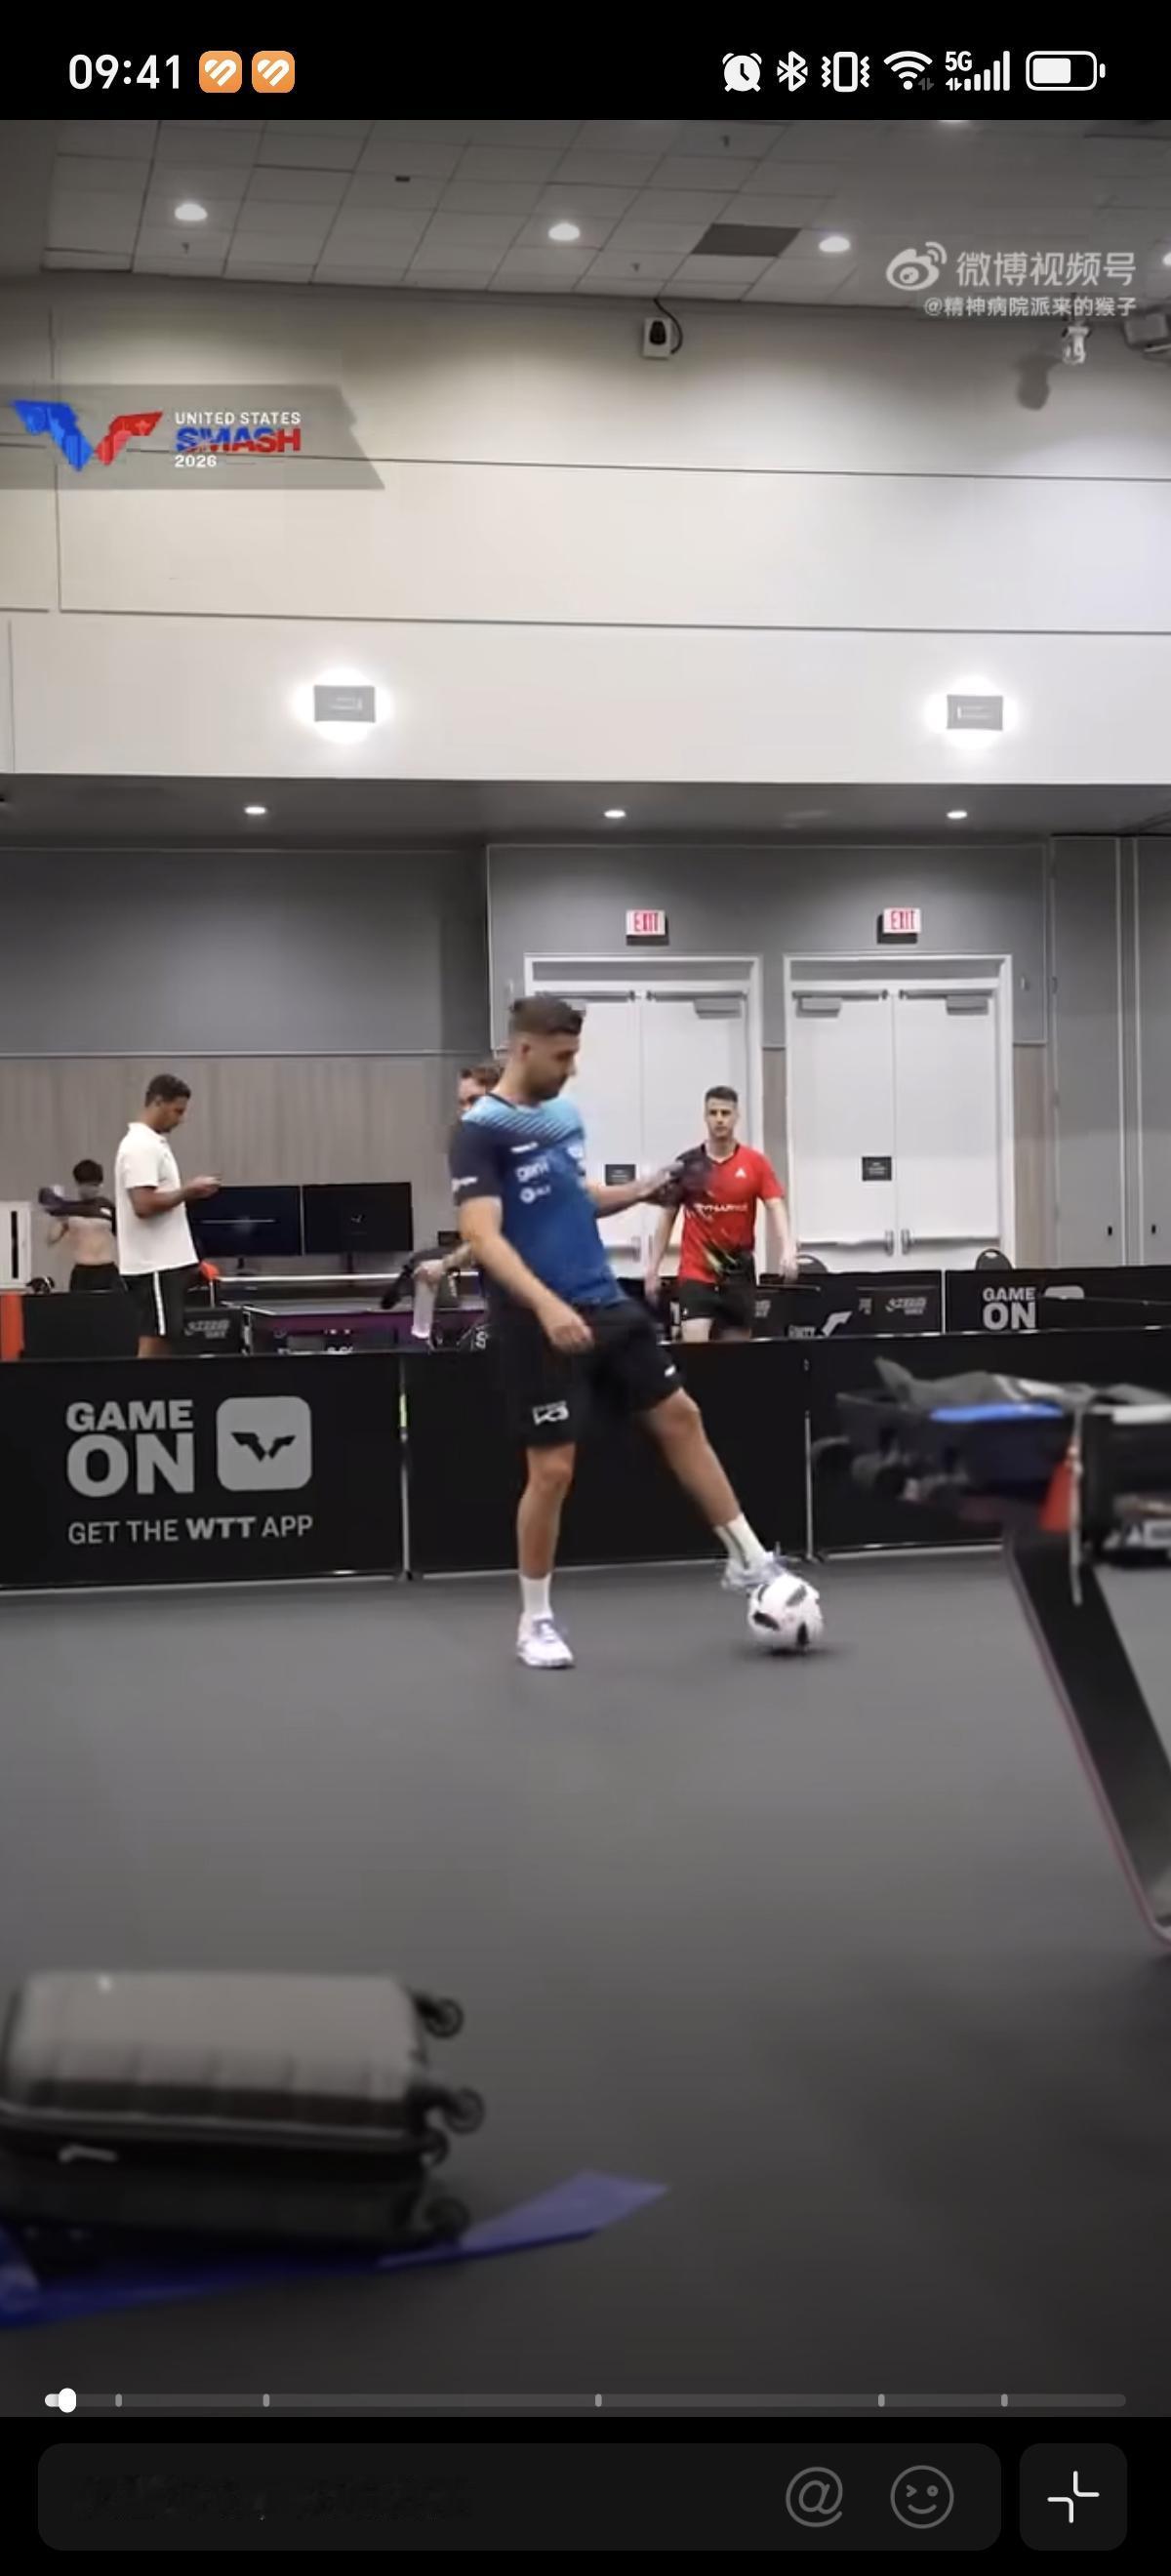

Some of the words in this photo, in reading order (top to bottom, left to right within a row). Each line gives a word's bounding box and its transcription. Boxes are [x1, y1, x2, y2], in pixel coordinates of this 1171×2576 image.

[982, 1286, 1036, 1303] GAME
[983, 1302, 1036, 1330] ON
[66, 1399, 194, 1431] GAME
[66, 1432, 195, 1498] ON
[68, 1521, 119, 1545] GET
[126, 1519, 179, 1543] THE
[185, 1516, 256, 1540] WTT
[262, 1514, 313, 1538] APP
